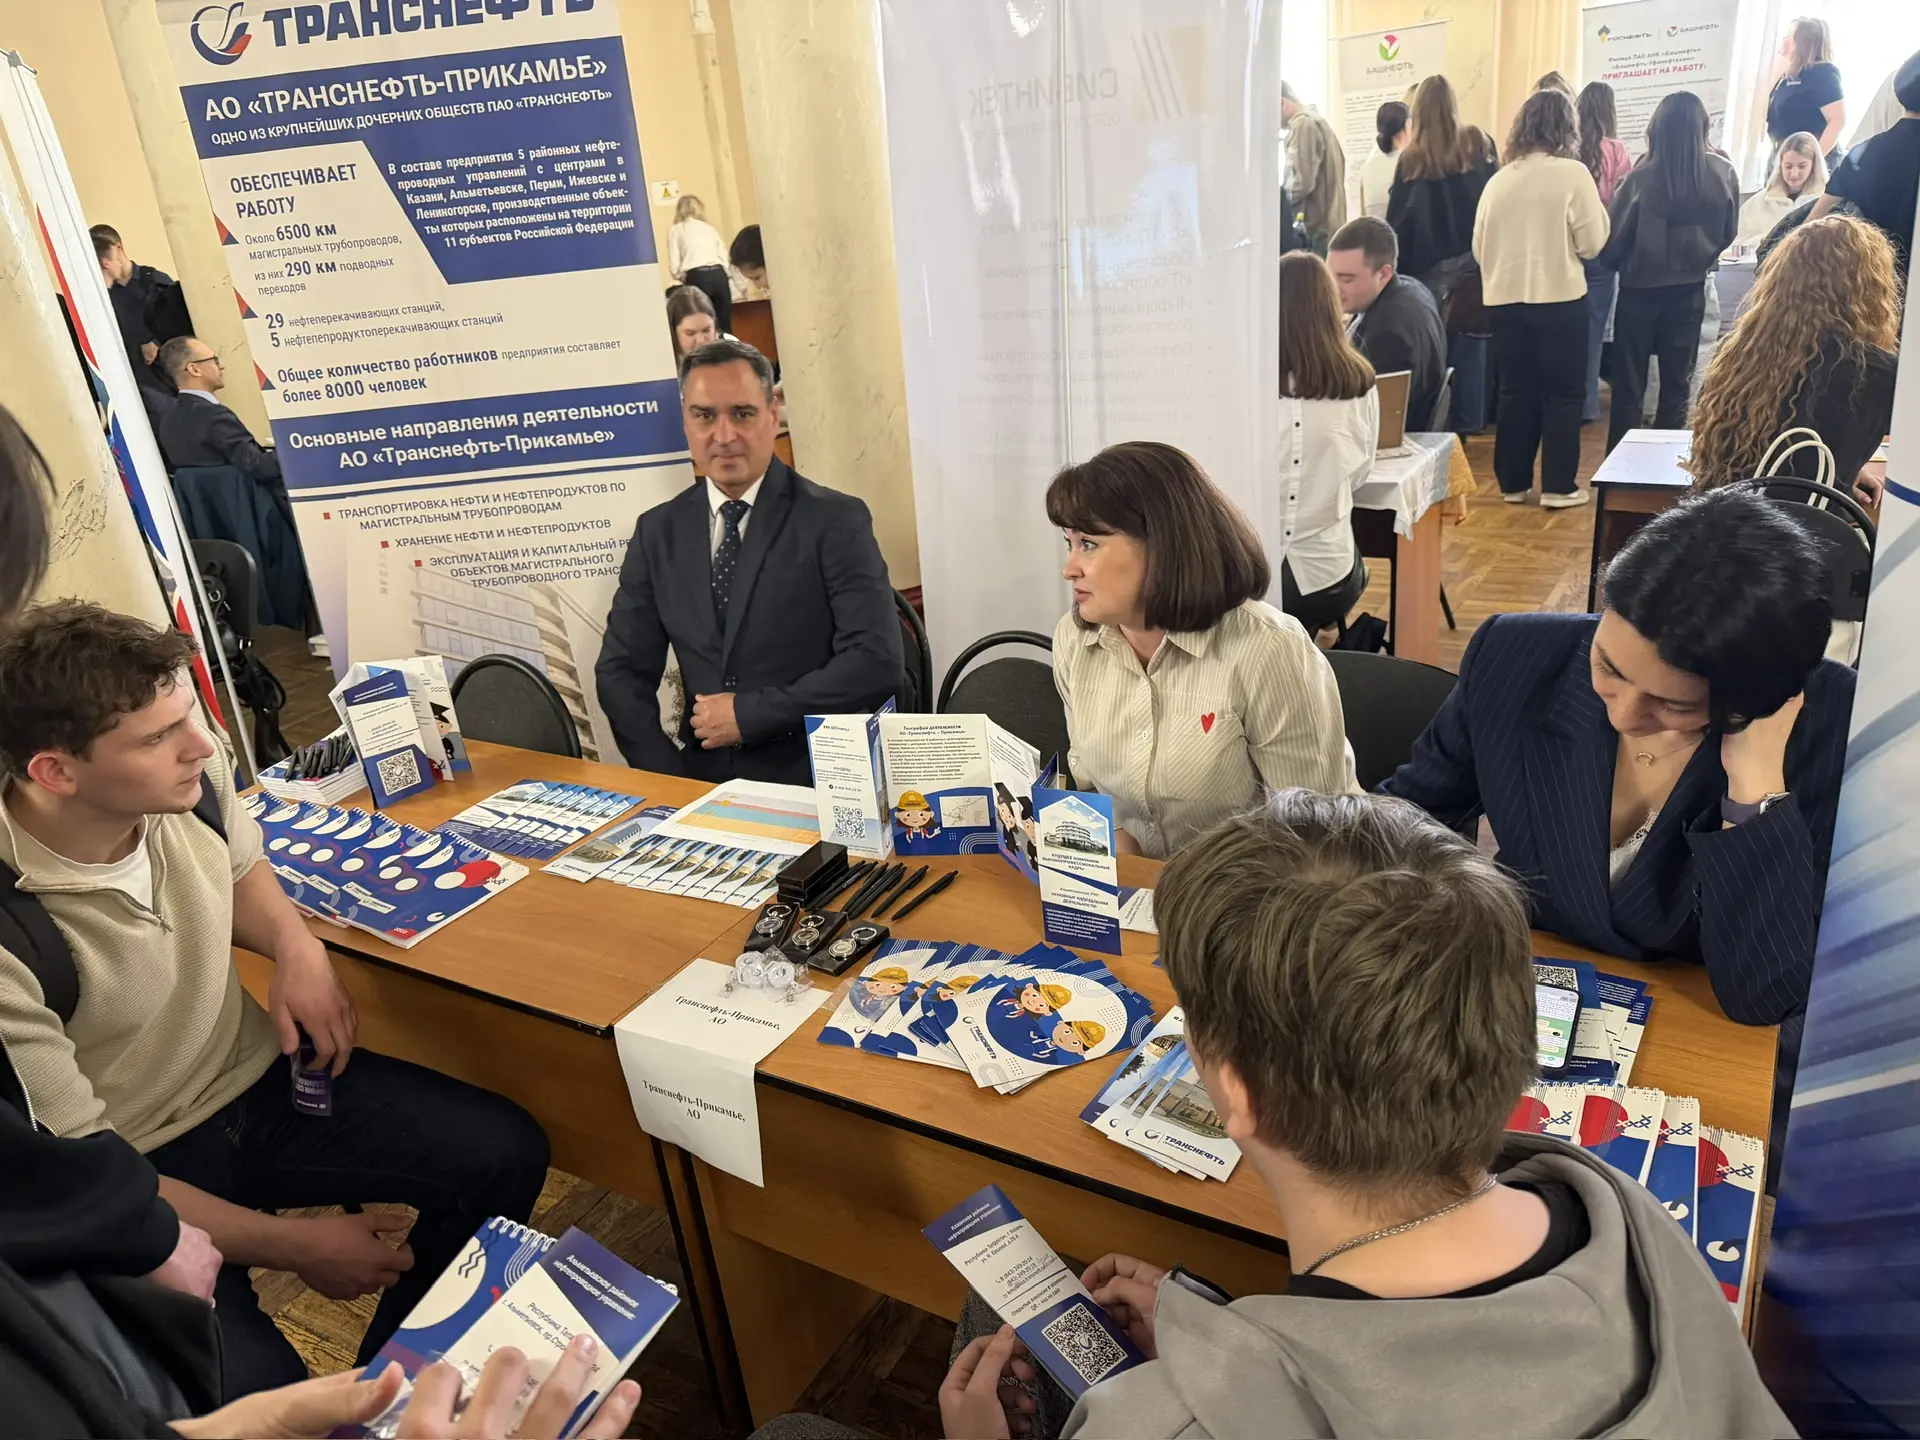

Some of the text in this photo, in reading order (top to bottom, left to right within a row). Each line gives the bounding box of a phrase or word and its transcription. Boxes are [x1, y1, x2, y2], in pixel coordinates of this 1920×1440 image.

[204, 54, 608, 122] АО «ТРАНСНЕФТЬ-ПРИКАМЬЕ»
[1602, 67, 1658, 80] ПРИГЛАШАЕТ
[1659, 66, 1671, 75] НА
[211, 89, 612, 146] ОДНО ИЗ КРУПНЕЙШИХ ДОЧЕРНИХ ОБЩЕСТВ ПАО «ТРАНСНЕФТЬ»
[388, 141, 621, 174] В составе предприятия 5 районных нефте-
[230, 163, 358, 195] ОБЕСПЕЧИВАЕТ
[397, 174, 456, 192] проводных
[465, 166, 526, 185] управлений
[553, 158, 606, 174] центрами
[406, 191, 446, 206] Казани,
[449, 180, 527, 201] Альметьевске,
[529, 178, 566, 194] Перми,
[568, 172, 615, 188] Ижевске
[236, 196, 296, 219] РАБОТУ
[416, 188, 628, 220] Лениногорске, производственные объек-
[425, 202, 632, 235] ты которых расположены на территории
[245, 222, 337, 246] Около 6500 км
[249, 234, 402, 260] магистральных трубопроводов,
[444, 218, 634, 248] 11 субъектов Российской Федерации
[254, 256, 394, 282] из них 290 км подводных
[258, 280, 306, 298] переходов
[264, 300, 445, 330] 29 нефтеперекачивающих станций,
[270, 332, 280, 348] 5
[461, 312, 504, 327] станций
[277, 340, 622, 384] Общее количество работников предприятия составляет
[282, 376, 428, 404] более 8000 человек
[289, 398, 658, 450] Основные направления деятельности
[339, 429, 616, 469] АО «Транснефть-Прикамье»
[338, 482, 626, 520] ТРАНСПОРТИРОВКА НЕФТИ И НЕФТЕПРОДУКТОВ ПО
[360, 502, 562, 530] МАГИСТРАЛЬНЫМ ТРУБОПРОВОДАМ
[395, 518, 612, 549] ХРАНЕНИЕ НЕФТИ И НЕФТЕПРОДУКТОВ
[430, 549, 519, 568] ЭКСПЛУАТАЦИЯ
[521, 548, 530, 558] И
[532, 538, 616, 556] КАПИТАЛЬНЫЙ
[450, 554, 614, 578] ОБЪЕКТОВ МАГИСТРАЛЬНОГО
[472, 566, 620, 588] ТРУБОПРОВОДНОГО ТРАНС
[676, 995, 780, 1030] Транснефть-Прикамье,
[708, 1016, 728, 1026] АО
[642, 1080, 746, 1122] Транснефть-Прикамье,
[686, 1108, 701, 1120] АО
[1164, 1134, 1226, 1166] ТРАНСНЕФТЬ
[527, 1302, 562, 1331] Республика
